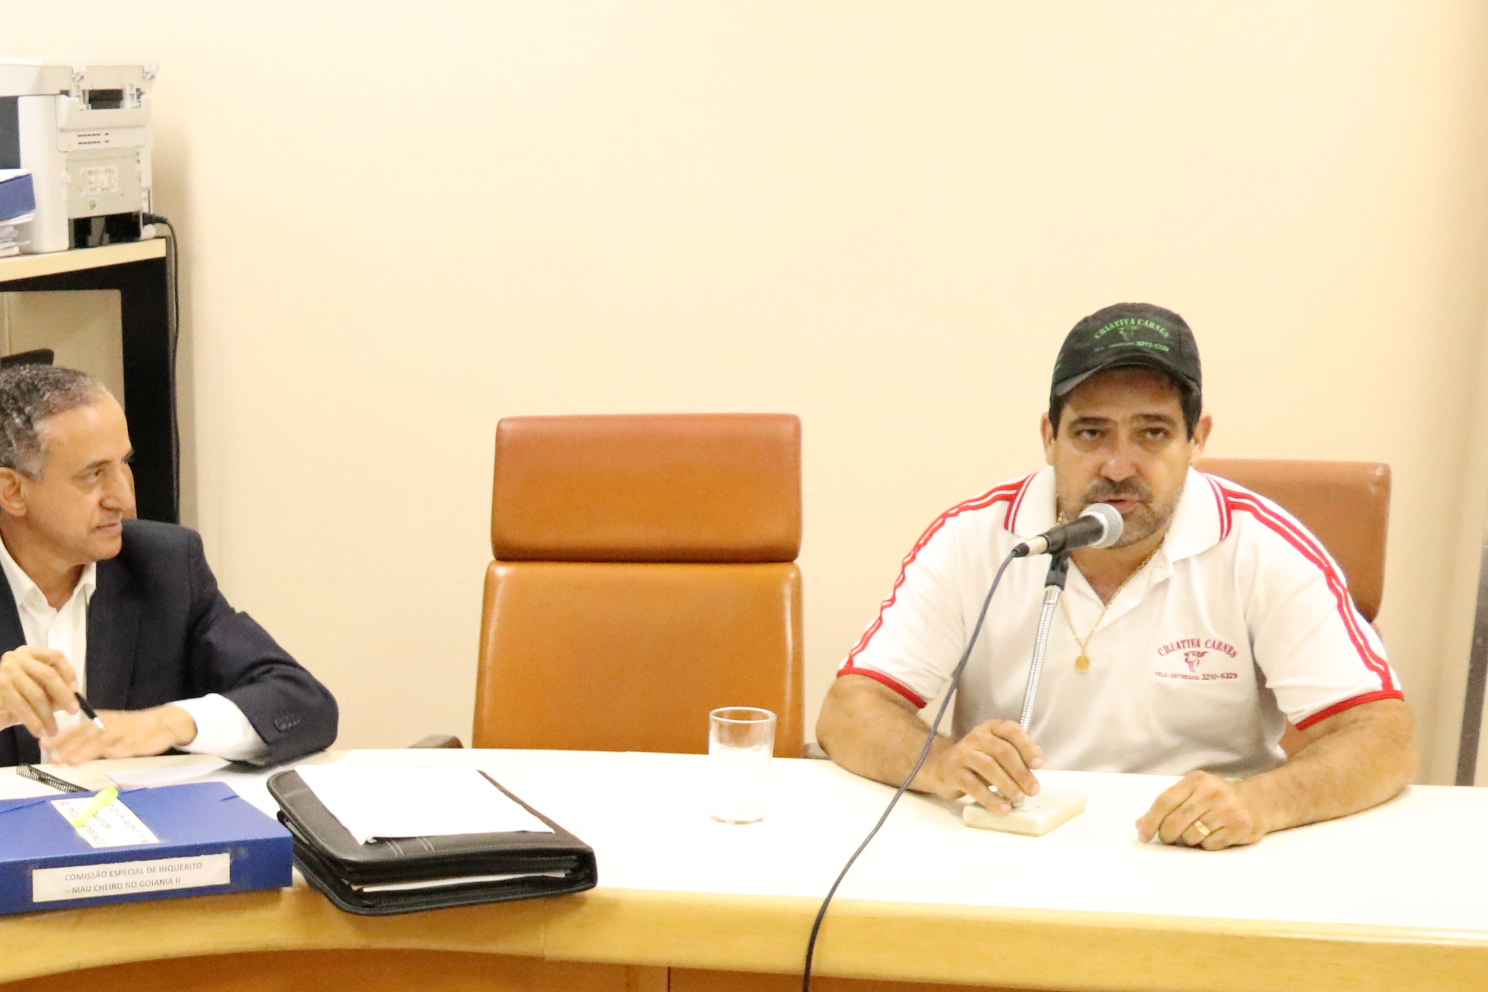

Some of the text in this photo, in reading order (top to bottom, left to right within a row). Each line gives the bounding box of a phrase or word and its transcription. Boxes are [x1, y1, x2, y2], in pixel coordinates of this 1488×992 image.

[1093, 318, 1170, 338] CRIATIVA CARNES
[1157, 638, 1238, 658] CRIATIVA CARNES
[65, 869, 108, 881] COMISSÃO
[109, 867, 144, 877] ESPECIAL
[146, 866, 156, 874] DE
[72, 885, 92, 893] MAU
[93, 883, 123, 892] CHEIRO
[125, 881, 137, 889] NO
